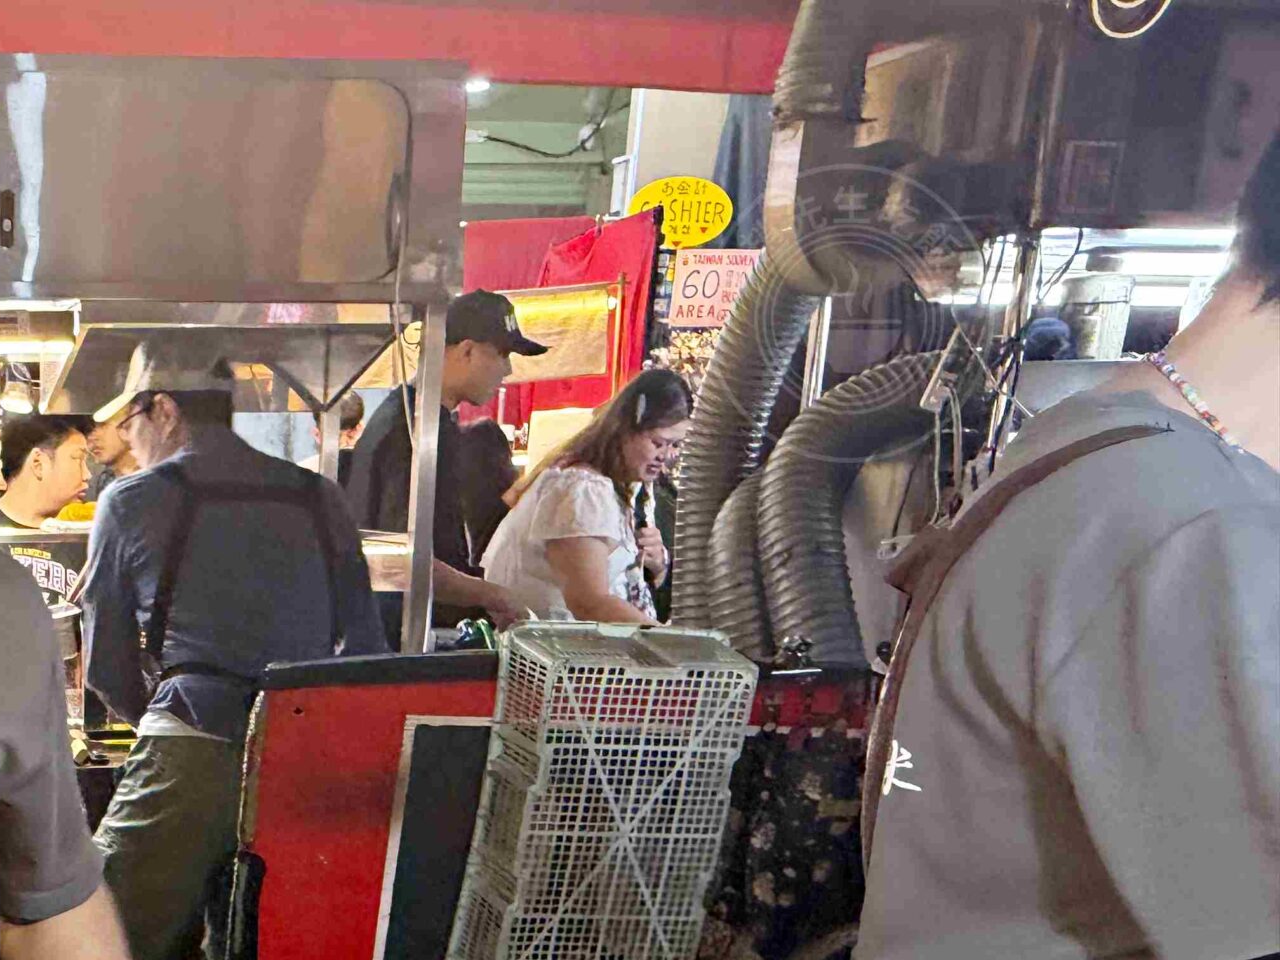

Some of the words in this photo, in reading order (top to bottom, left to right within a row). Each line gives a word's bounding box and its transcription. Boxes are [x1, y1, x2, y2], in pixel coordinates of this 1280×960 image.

[641, 199, 725, 223] CSHIER
[693, 254, 723, 265] TAIWAN
[682, 269, 720, 299] 60
[676, 304, 715, 319] AREA
